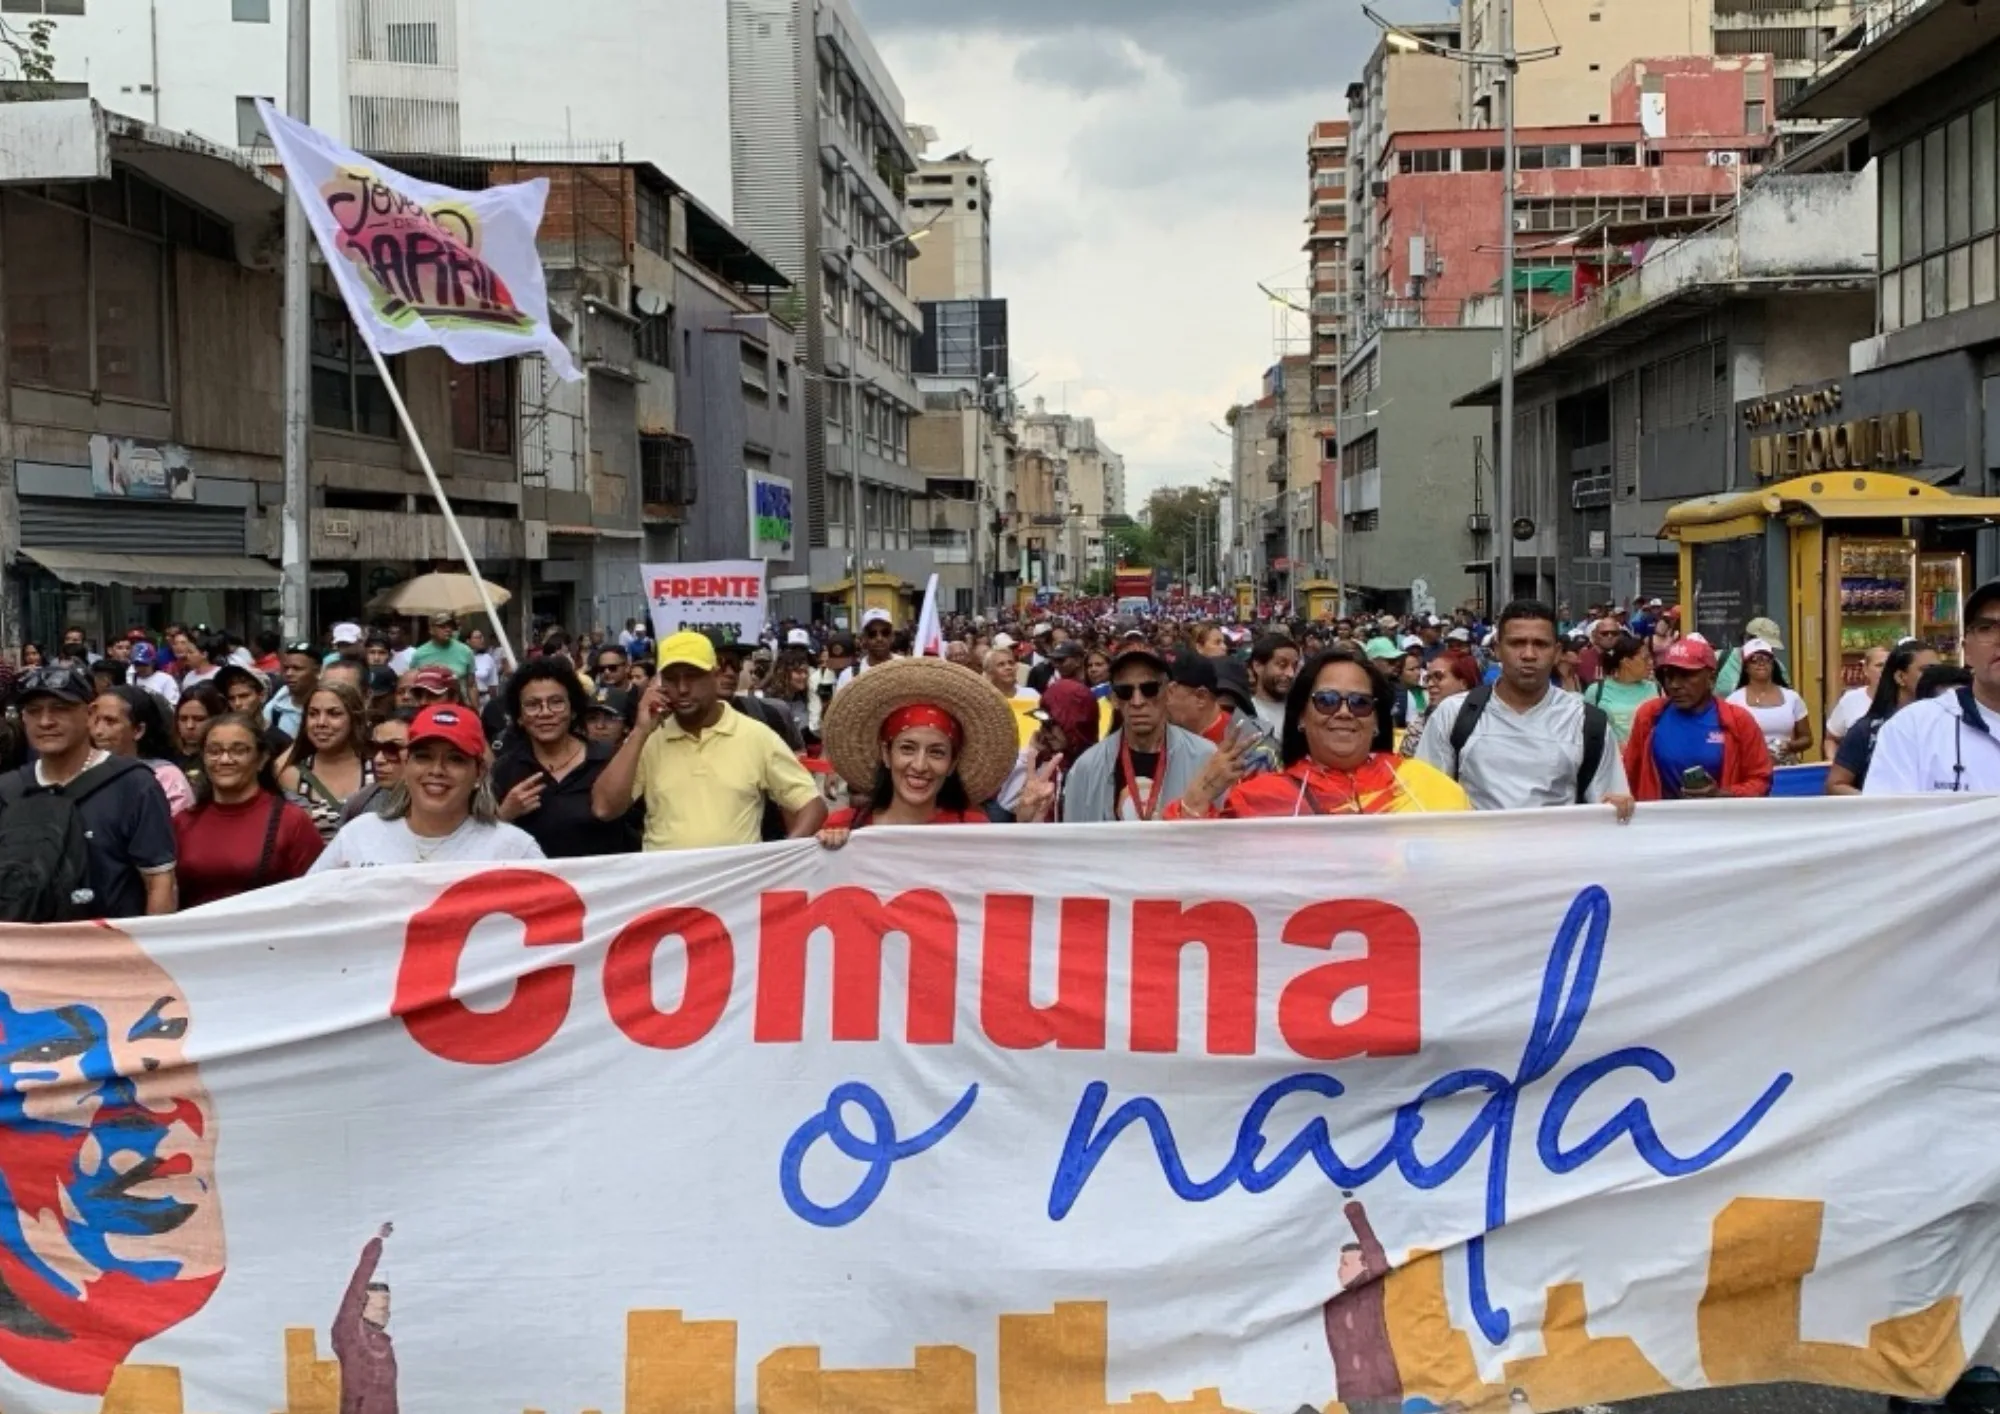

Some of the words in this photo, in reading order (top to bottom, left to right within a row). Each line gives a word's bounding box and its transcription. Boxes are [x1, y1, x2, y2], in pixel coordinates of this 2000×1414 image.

[653, 576, 760, 599] FRENTE
[393, 871, 1421, 1064] Comuna
[779, 1082, 979, 1227] o
[1047, 885, 1793, 1345] nada
